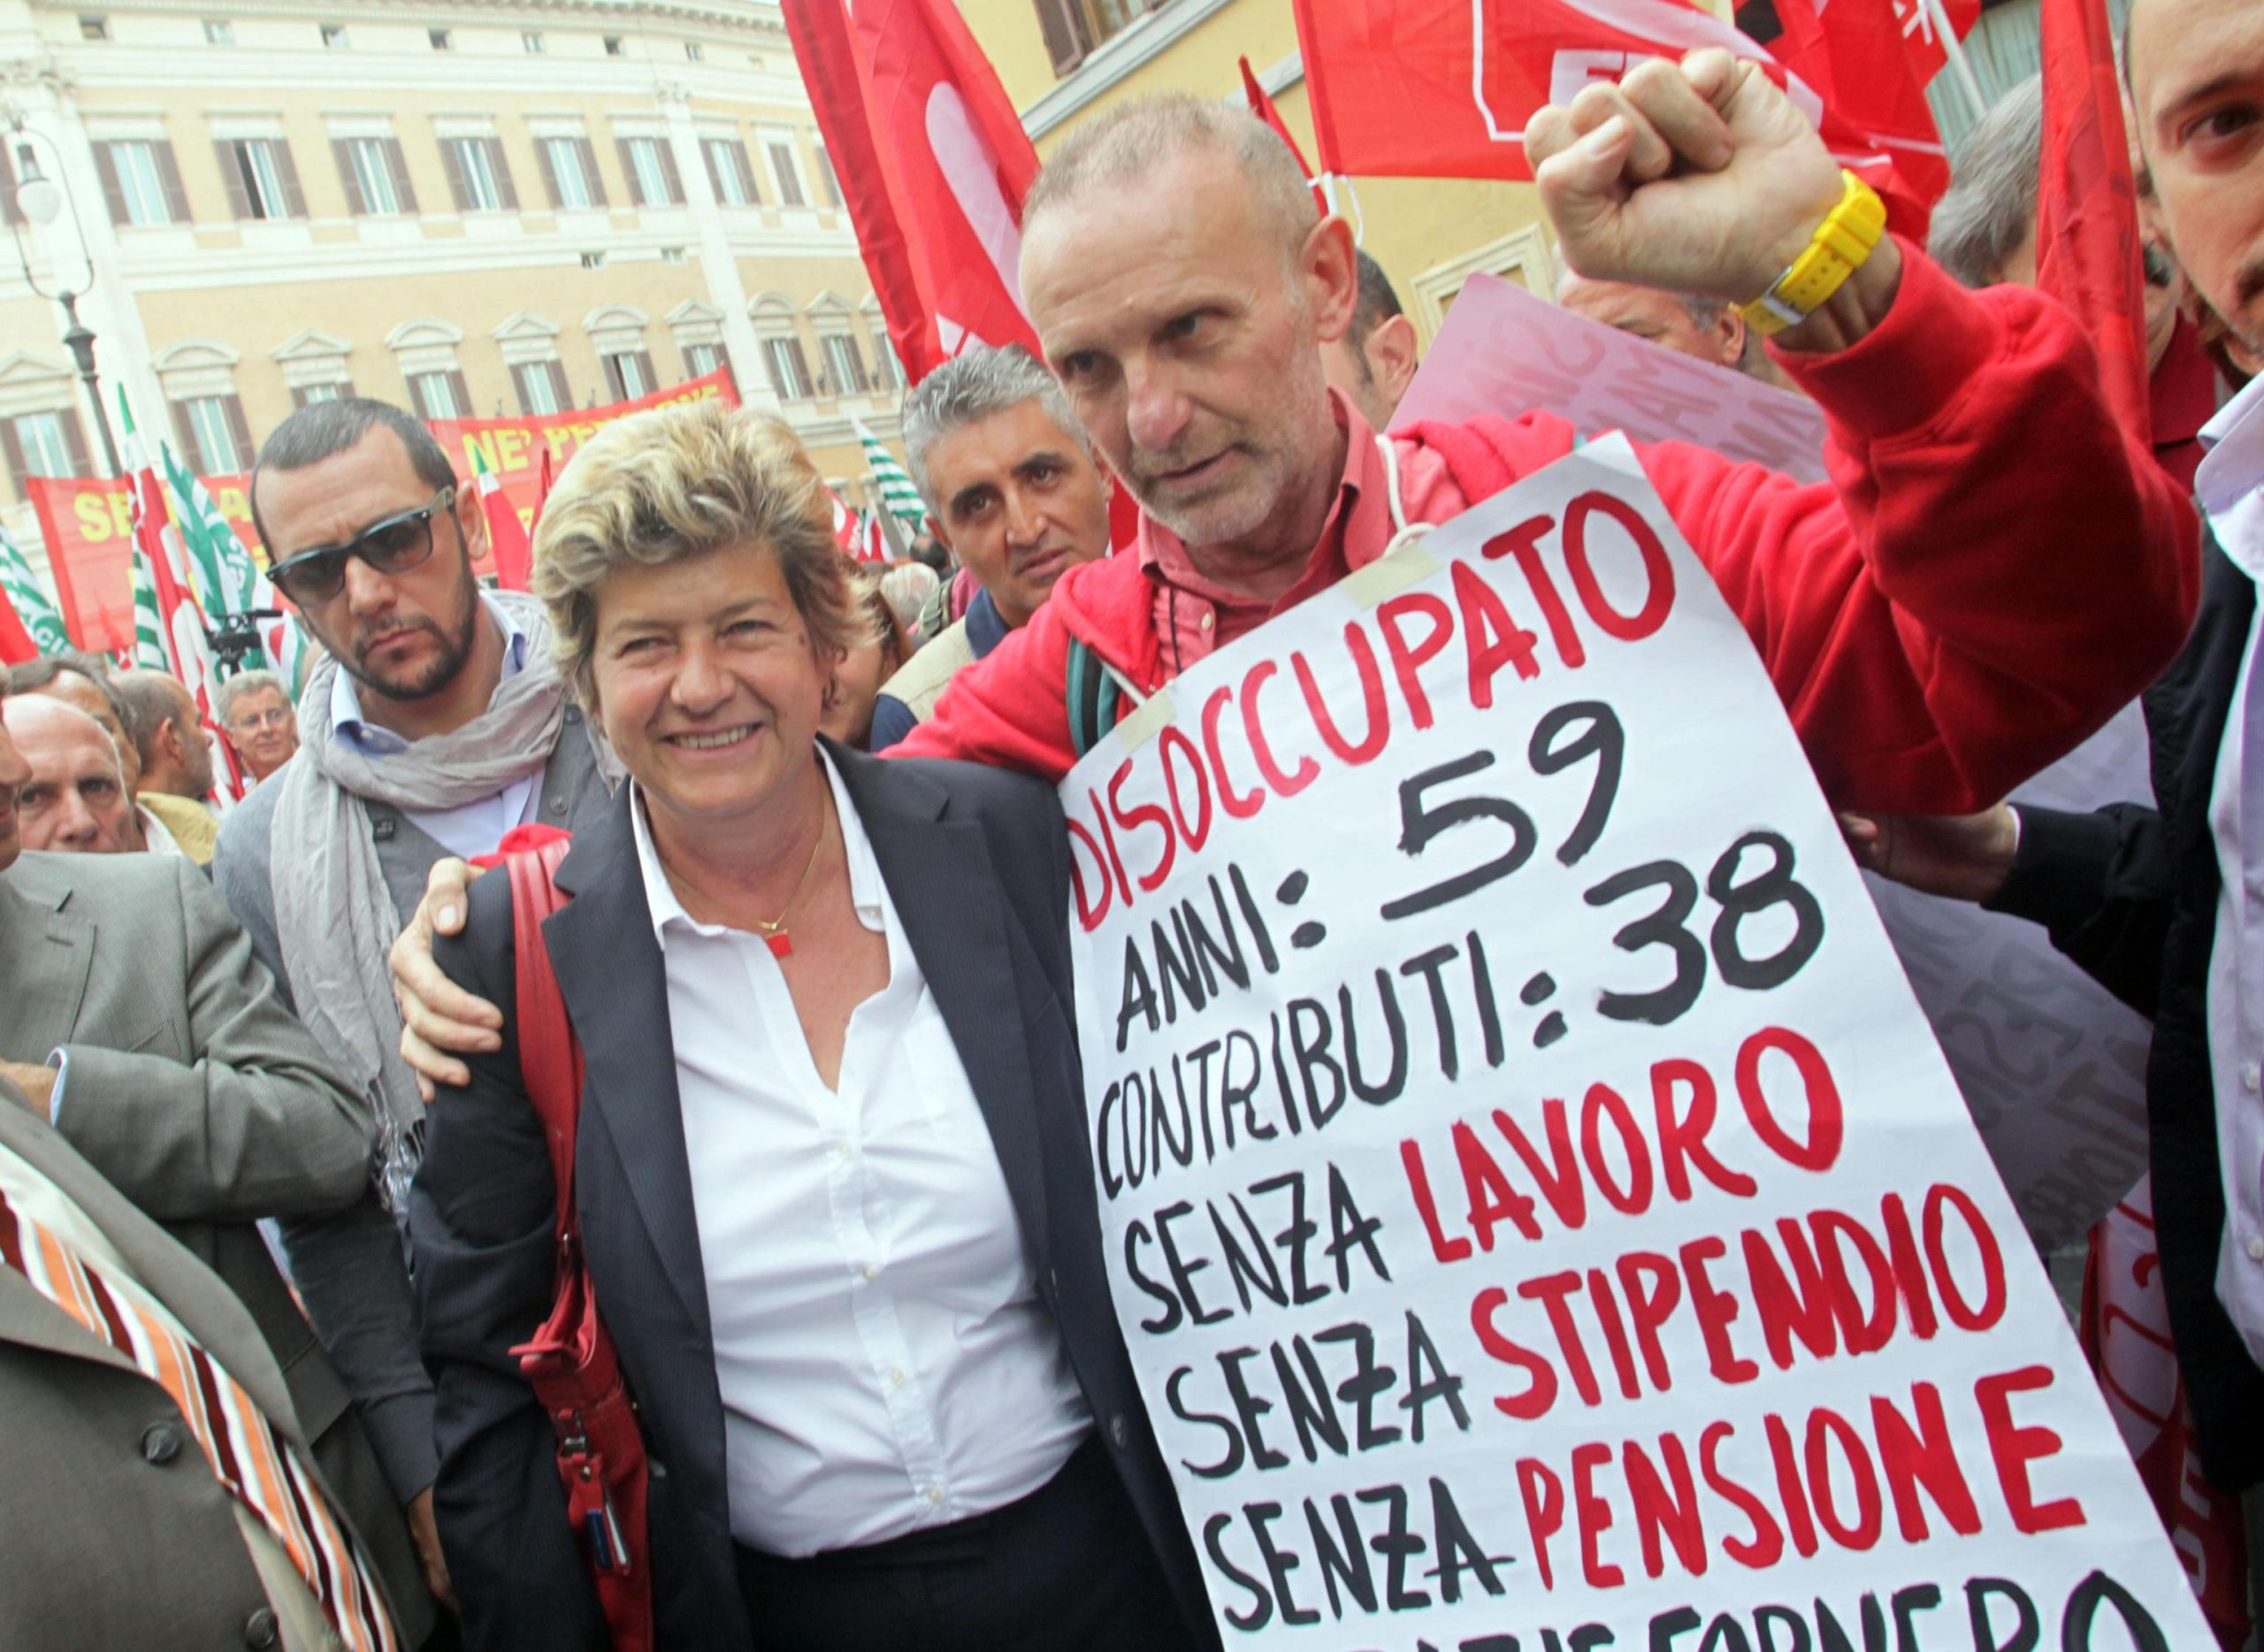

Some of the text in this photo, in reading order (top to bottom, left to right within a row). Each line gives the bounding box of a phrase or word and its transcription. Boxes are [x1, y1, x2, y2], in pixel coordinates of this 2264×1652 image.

[462, 429, 532, 479] NE'
[1067, 490, 1676, 933] DISOCCUPATO
[1098, 830, 1825, 1200] CONTRIBUTI: 38
[1116, 700, 1625, 1053] ANNI: 59
[1123, 1163, 1393, 1335] SENZA
[1400, 1025, 1844, 1264] LAVORO
[1165, 1310, 1470, 1479] SENZA
[1471, 1182, 2008, 1419] STIPENDIO
[1203, 1476, 1515, 1632] SENZA
[1515, 1364, 2087, 1591] PENSIONE
